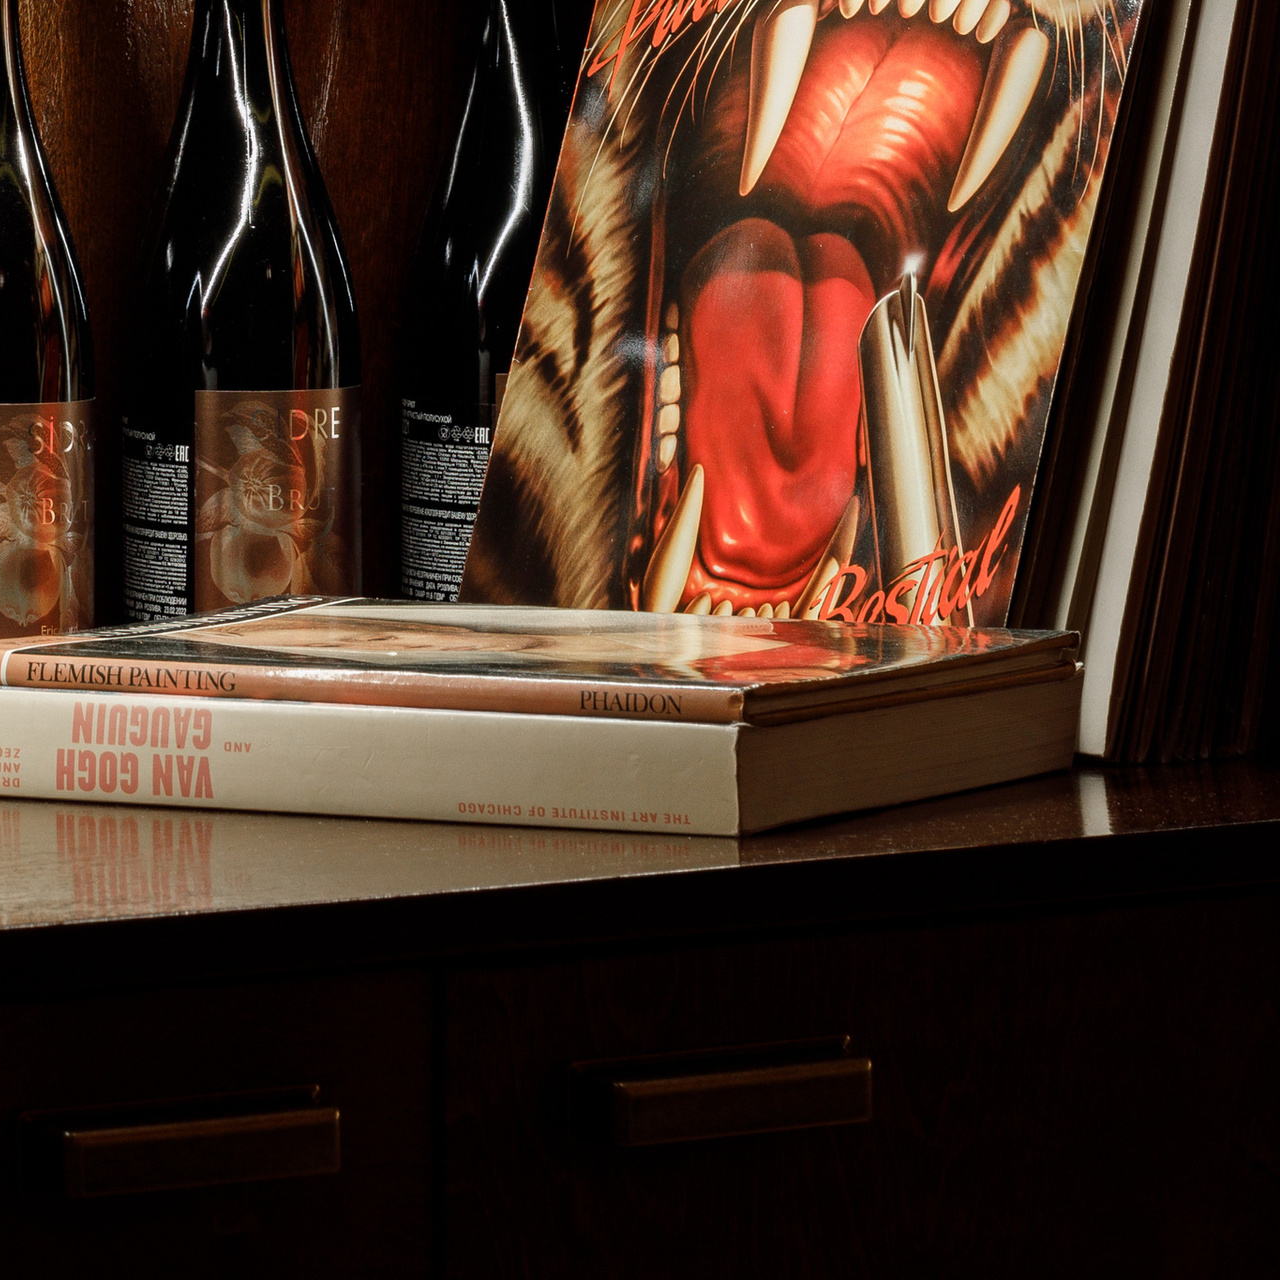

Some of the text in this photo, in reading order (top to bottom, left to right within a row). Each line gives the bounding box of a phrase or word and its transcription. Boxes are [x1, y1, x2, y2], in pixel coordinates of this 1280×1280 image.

[26, 662, 236, 691] FLEMISH PAINTING
[580, 690, 683, 715] PHAIDON
[71, 702, 252, 754] AND GAUGUIN
[56, 748, 214, 799] VAN GOGH
[458, 802, 691, 825] THE ART INSTITUTE OF CHICAGO
